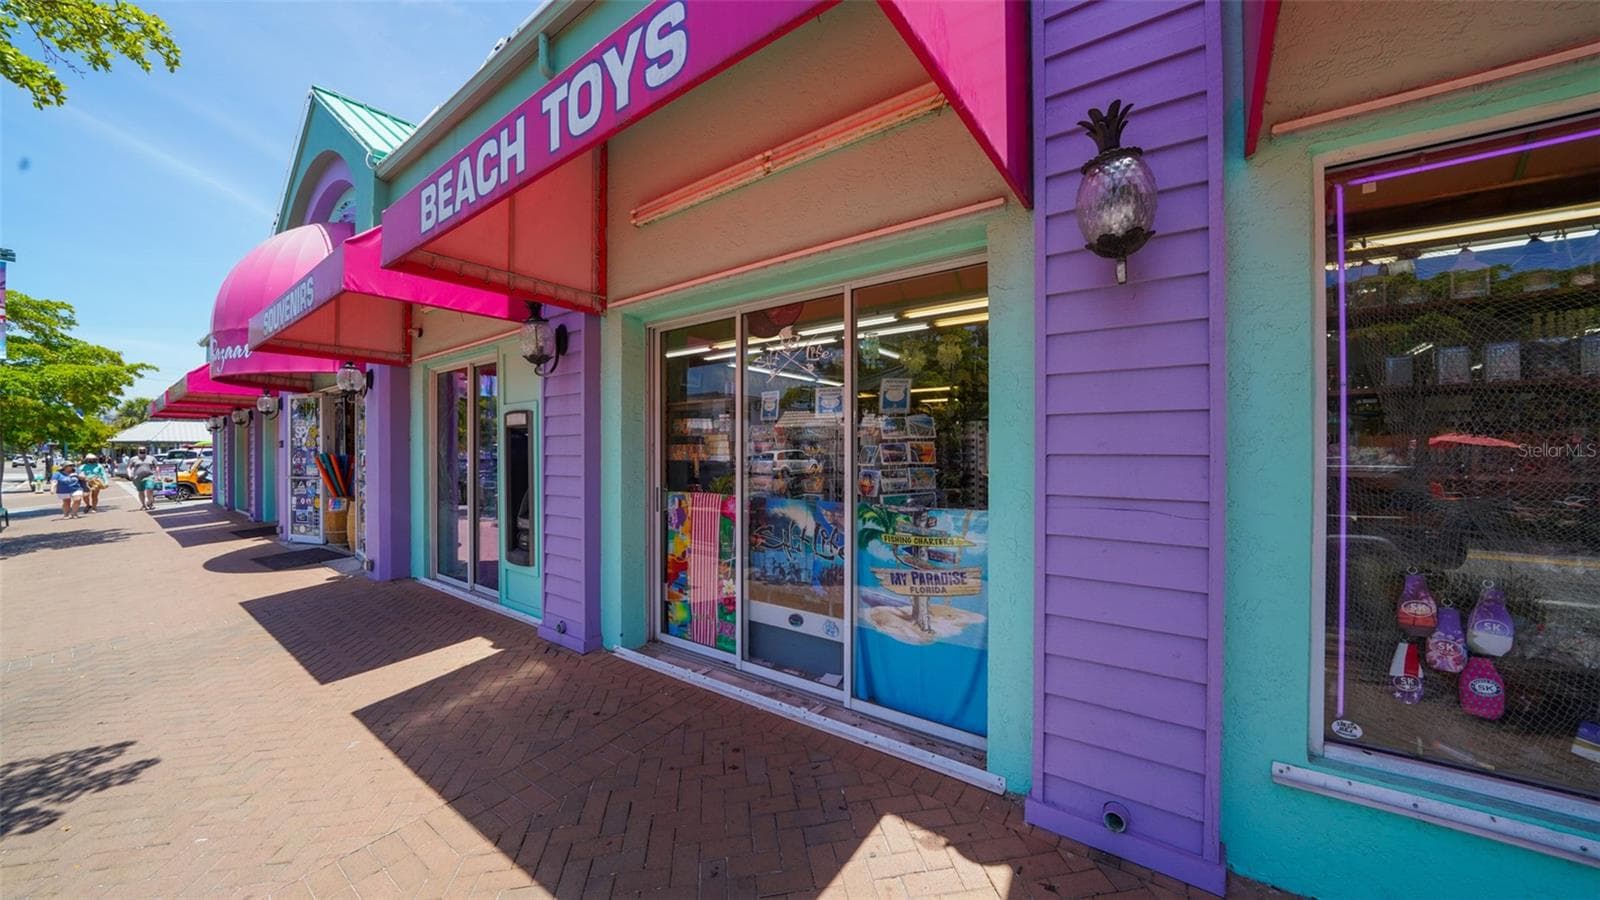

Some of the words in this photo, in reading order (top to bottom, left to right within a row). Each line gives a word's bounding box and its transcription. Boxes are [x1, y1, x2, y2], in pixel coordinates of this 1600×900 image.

[420, 115, 527, 235] BEACH
[541, 0, 688, 153] TOYS
[263, 276, 314, 336] SOUVENIRS
[883, 535, 912, 543] FISHING
[891, 573, 907, 586] MY
[912, 571, 968, 586] PARADISE
[910, 586, 948, 594] FLORIDA
[1484, 622, 1501, 631] SK
[1439, 642, 1454, 651] SK
[1400, 677, 1415, 685] SK
[1477, 685, 1494, 693] SK
